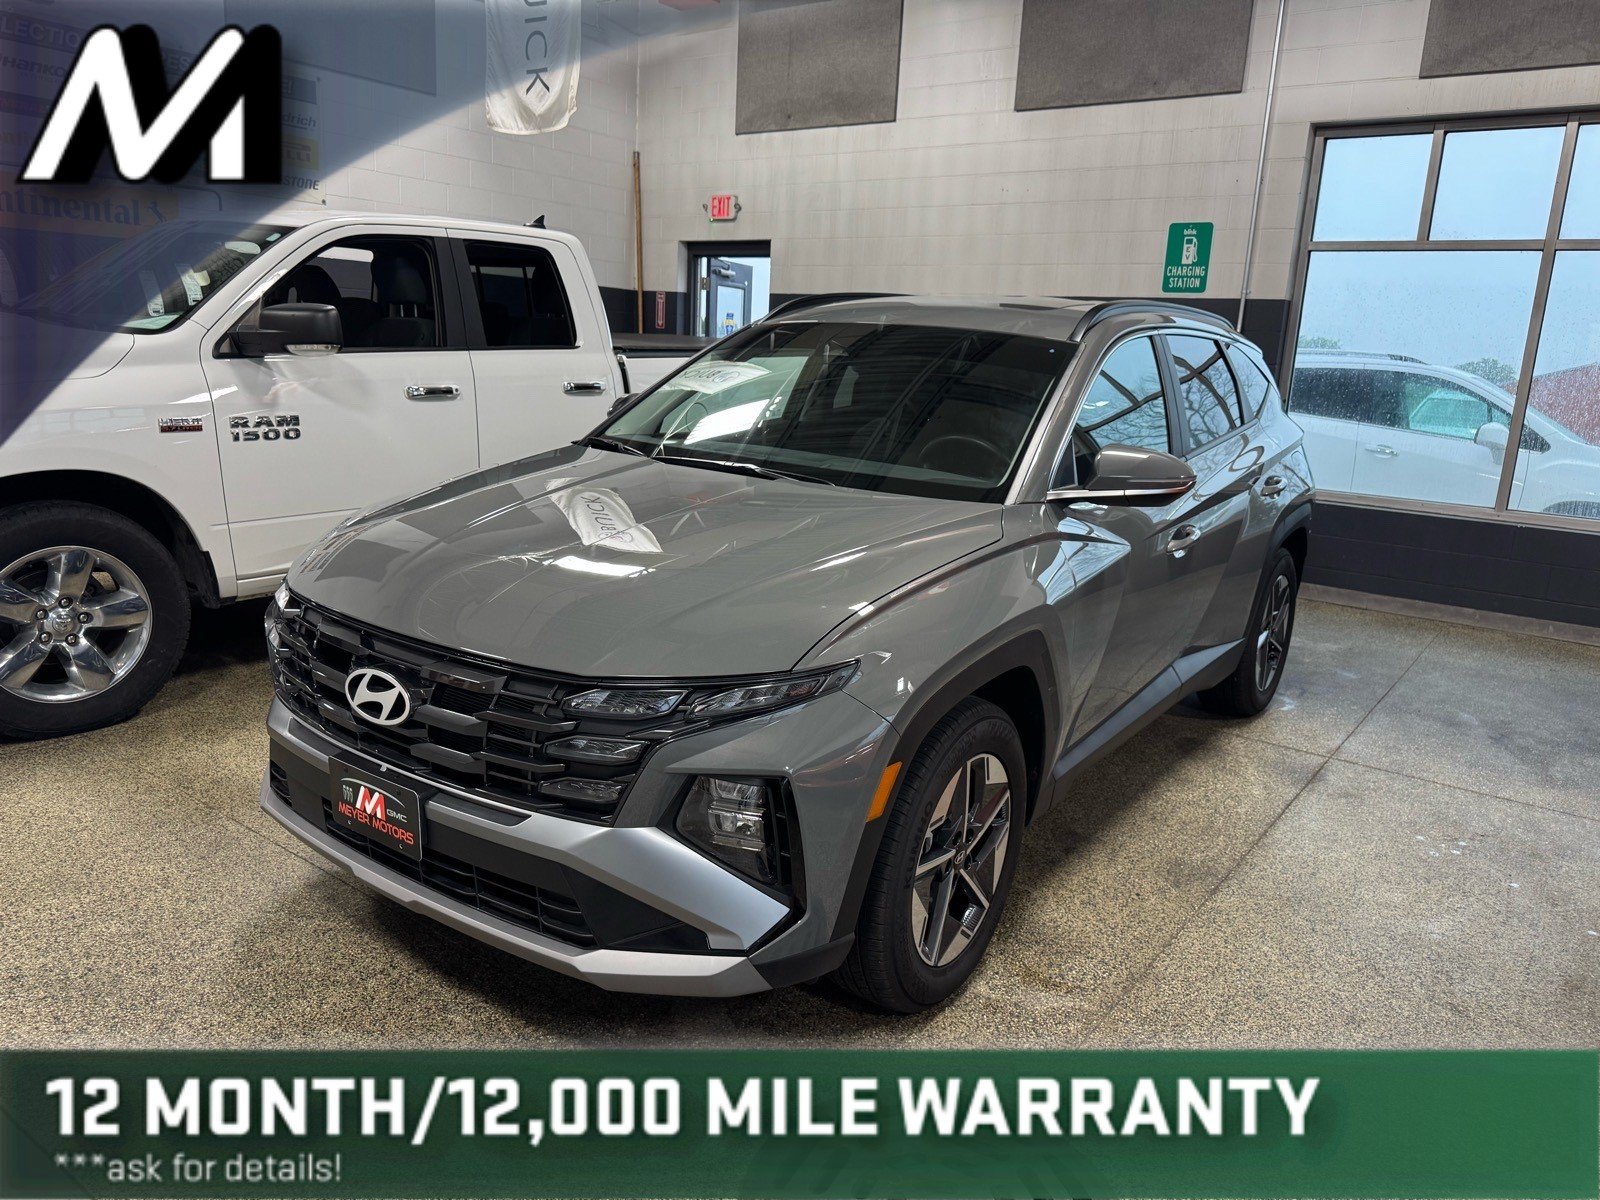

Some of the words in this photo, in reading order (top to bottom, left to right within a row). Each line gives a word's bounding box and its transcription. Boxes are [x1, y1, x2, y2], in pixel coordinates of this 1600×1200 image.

[0, 15, 81, 48] LECTIO
[0, 187, 142, 226] ntinental
[711, 196, 731, 218] EXIT
[1166, 266, 1206, 277] CHARGING
[1168, 277, 1201, 289] STATION
[229, 415, 300, 428] RAM
[230, 428, 301, 442] 1500
[338, 801, 370, 826] MEYER
[372, 818, 414, 845] MOTORS
[386, 808, 407, 823] GMC
